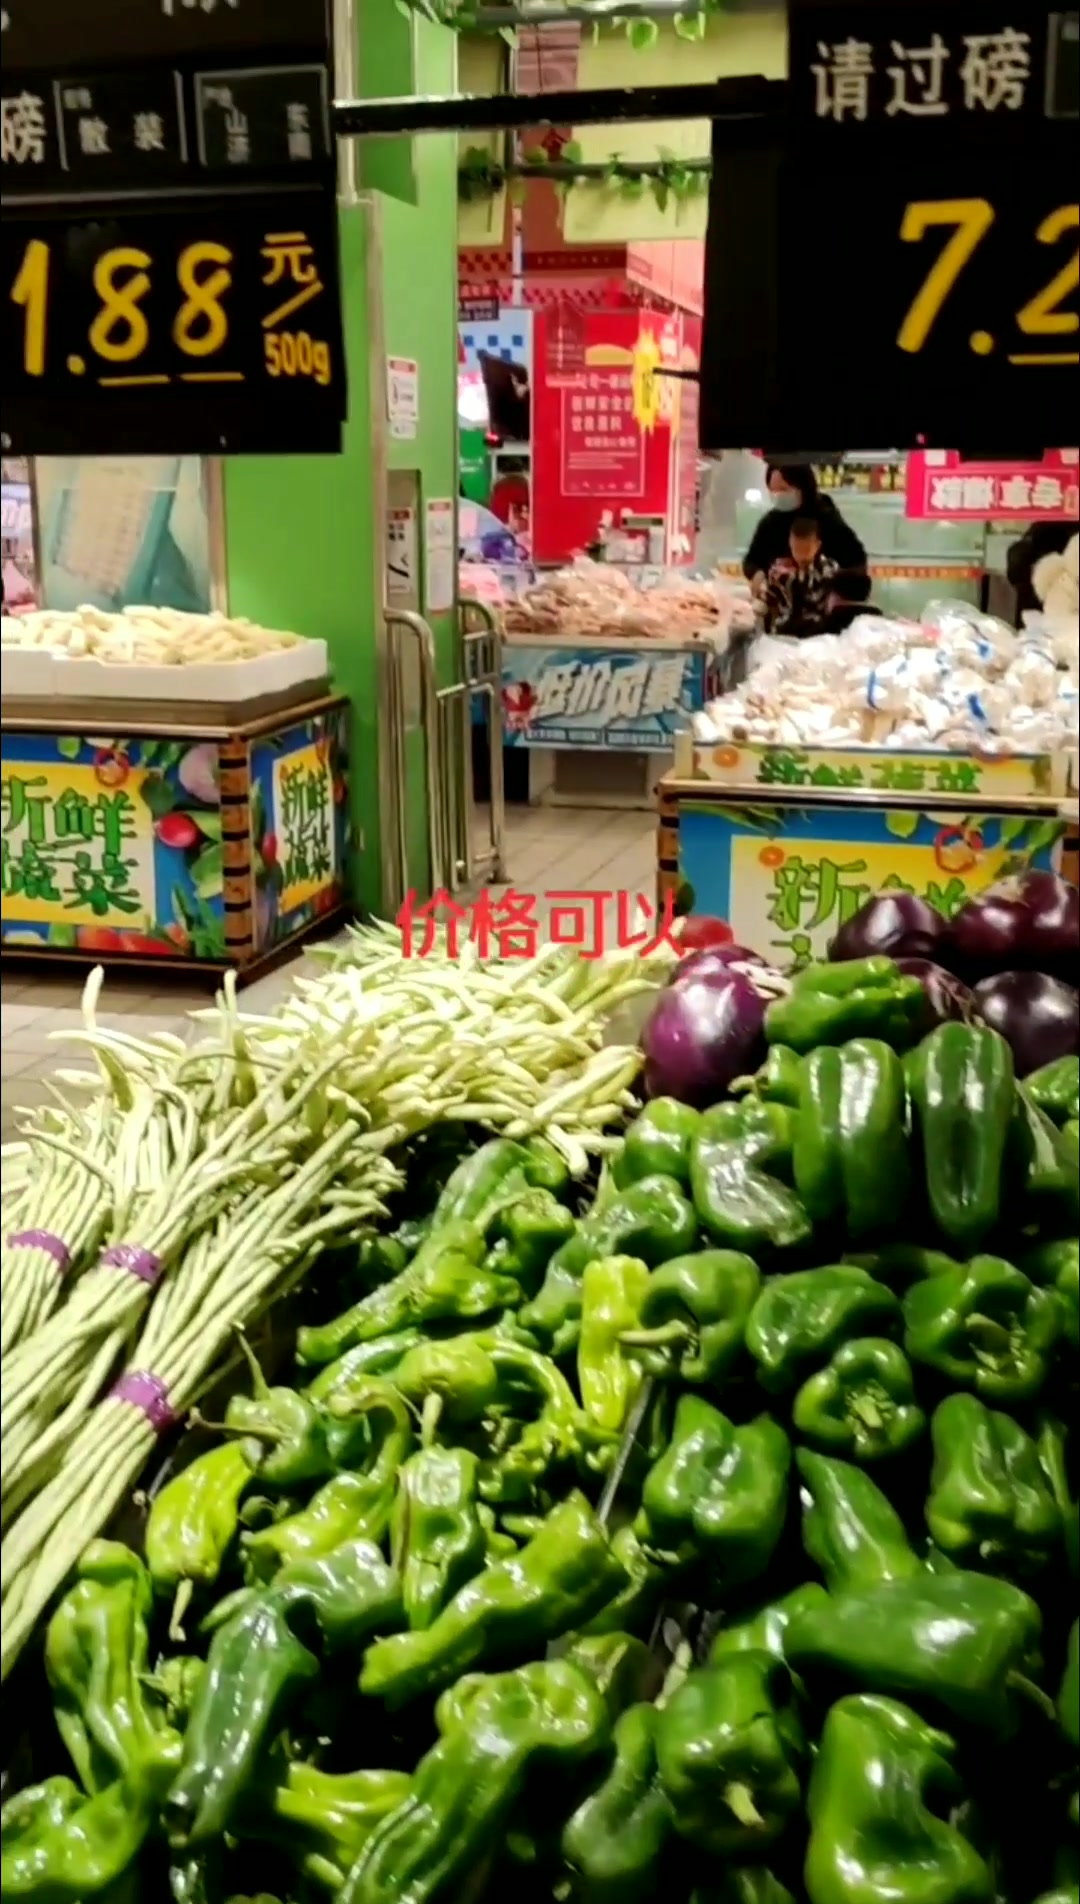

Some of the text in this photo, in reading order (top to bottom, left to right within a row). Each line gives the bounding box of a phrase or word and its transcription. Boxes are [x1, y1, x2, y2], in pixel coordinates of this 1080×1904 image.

[810, 27, 1032, 122] 请过磅
[10, 238, 232, 376] 1.88
[263, 331, 331, 385] 500g
